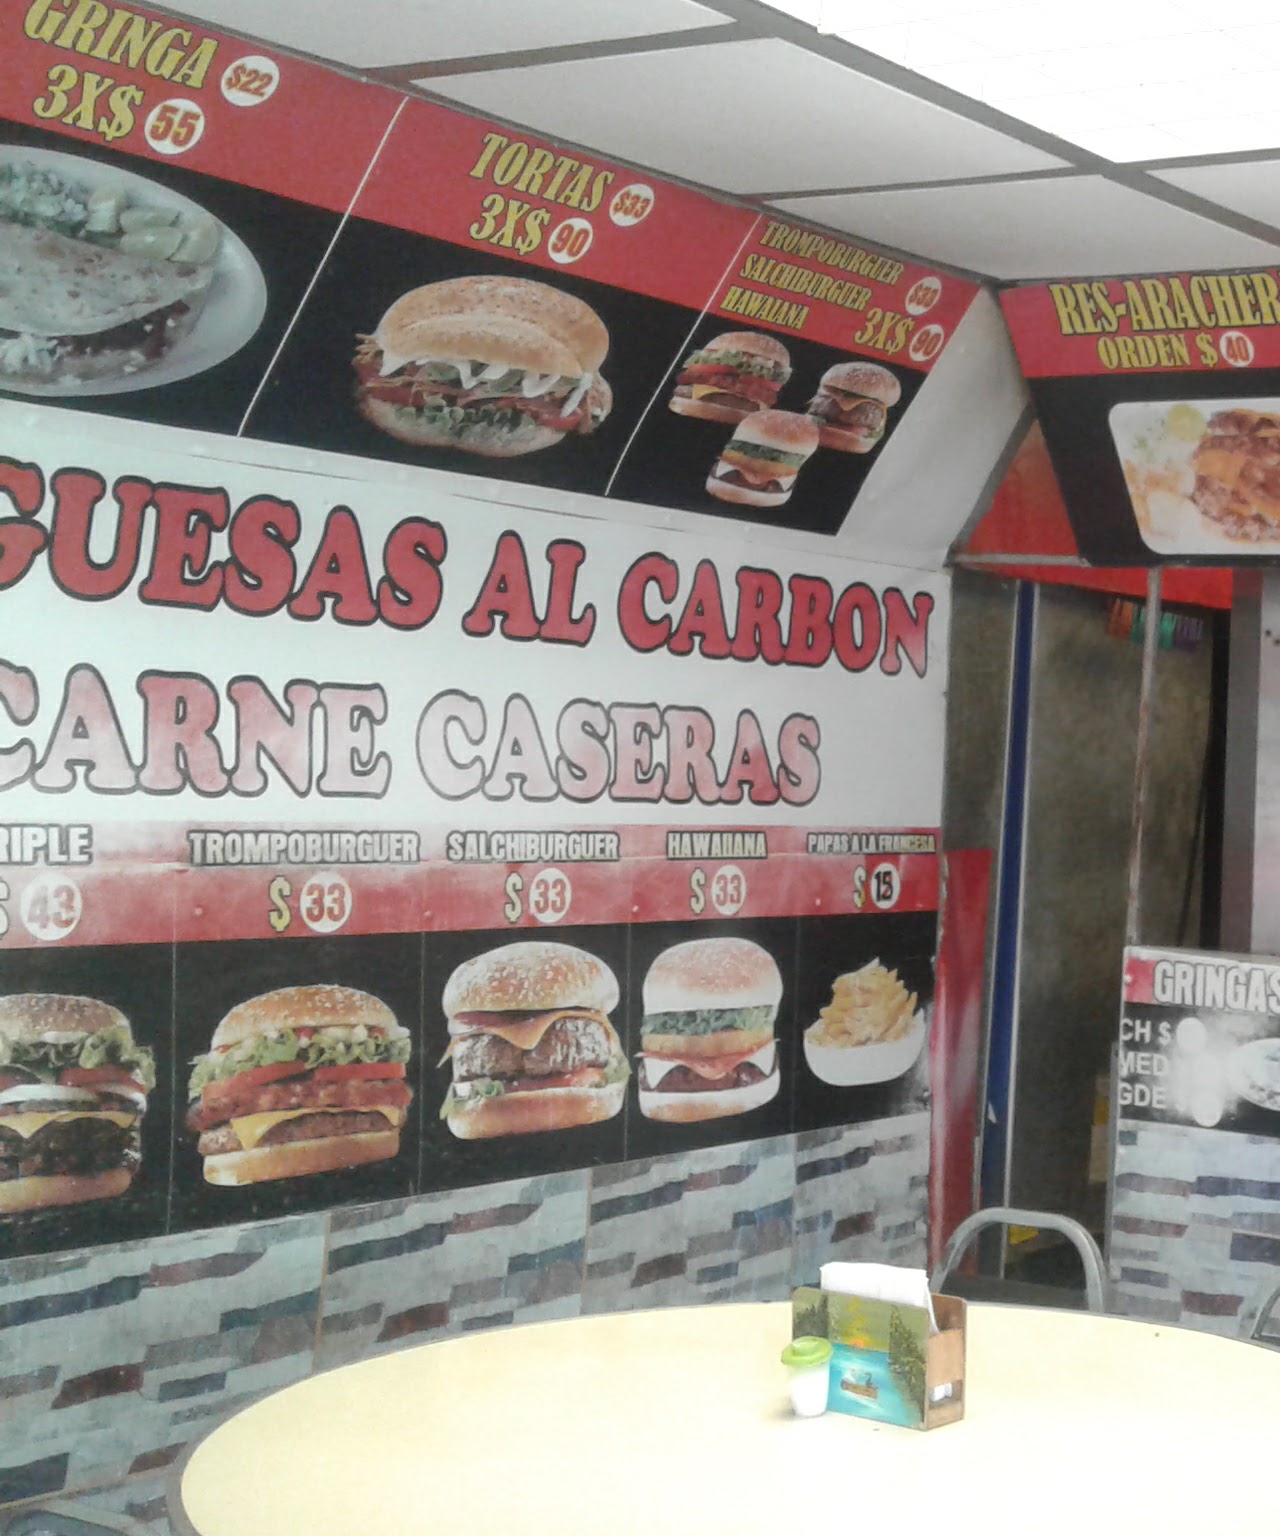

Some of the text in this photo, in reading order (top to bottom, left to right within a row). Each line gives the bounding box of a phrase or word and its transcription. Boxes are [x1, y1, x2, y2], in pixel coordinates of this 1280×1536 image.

[24, 0, 219, 89] GRINGA
[150, 103, 201, 148] 55
[470, 131, 616, 213] TORTAS
[550, 223, 592, 258] 90
[759, 220, 904, 286] TROMPOBURGUER
[739, 252, 873, 312] SALCHIBURGUER
[1096, 334, 1191, 370] ORDEN
[1225, 338, 1249, 365] 40
[461, 530, 598, 647] AL
[616, 550, 934, 679] CARBON
[415, 687, 822, 807] CASERAS
[187, 829, 421, 867] TROMPOBURGUER
[447, 830, 620, 864] SALCHIBURGUER
[806, 832, 850, 855] PAPAS
[861, 833, 878, 855] LA
[305, 883, 347, 924] 33
[535, 878, 567, 915] 33
[712, 874, 743, 907] 33
[874, 870, 894, 902] 15
[1119, 1018, 1151, 1043] CH
[1118, 1082, 1168, 1110] GDE
